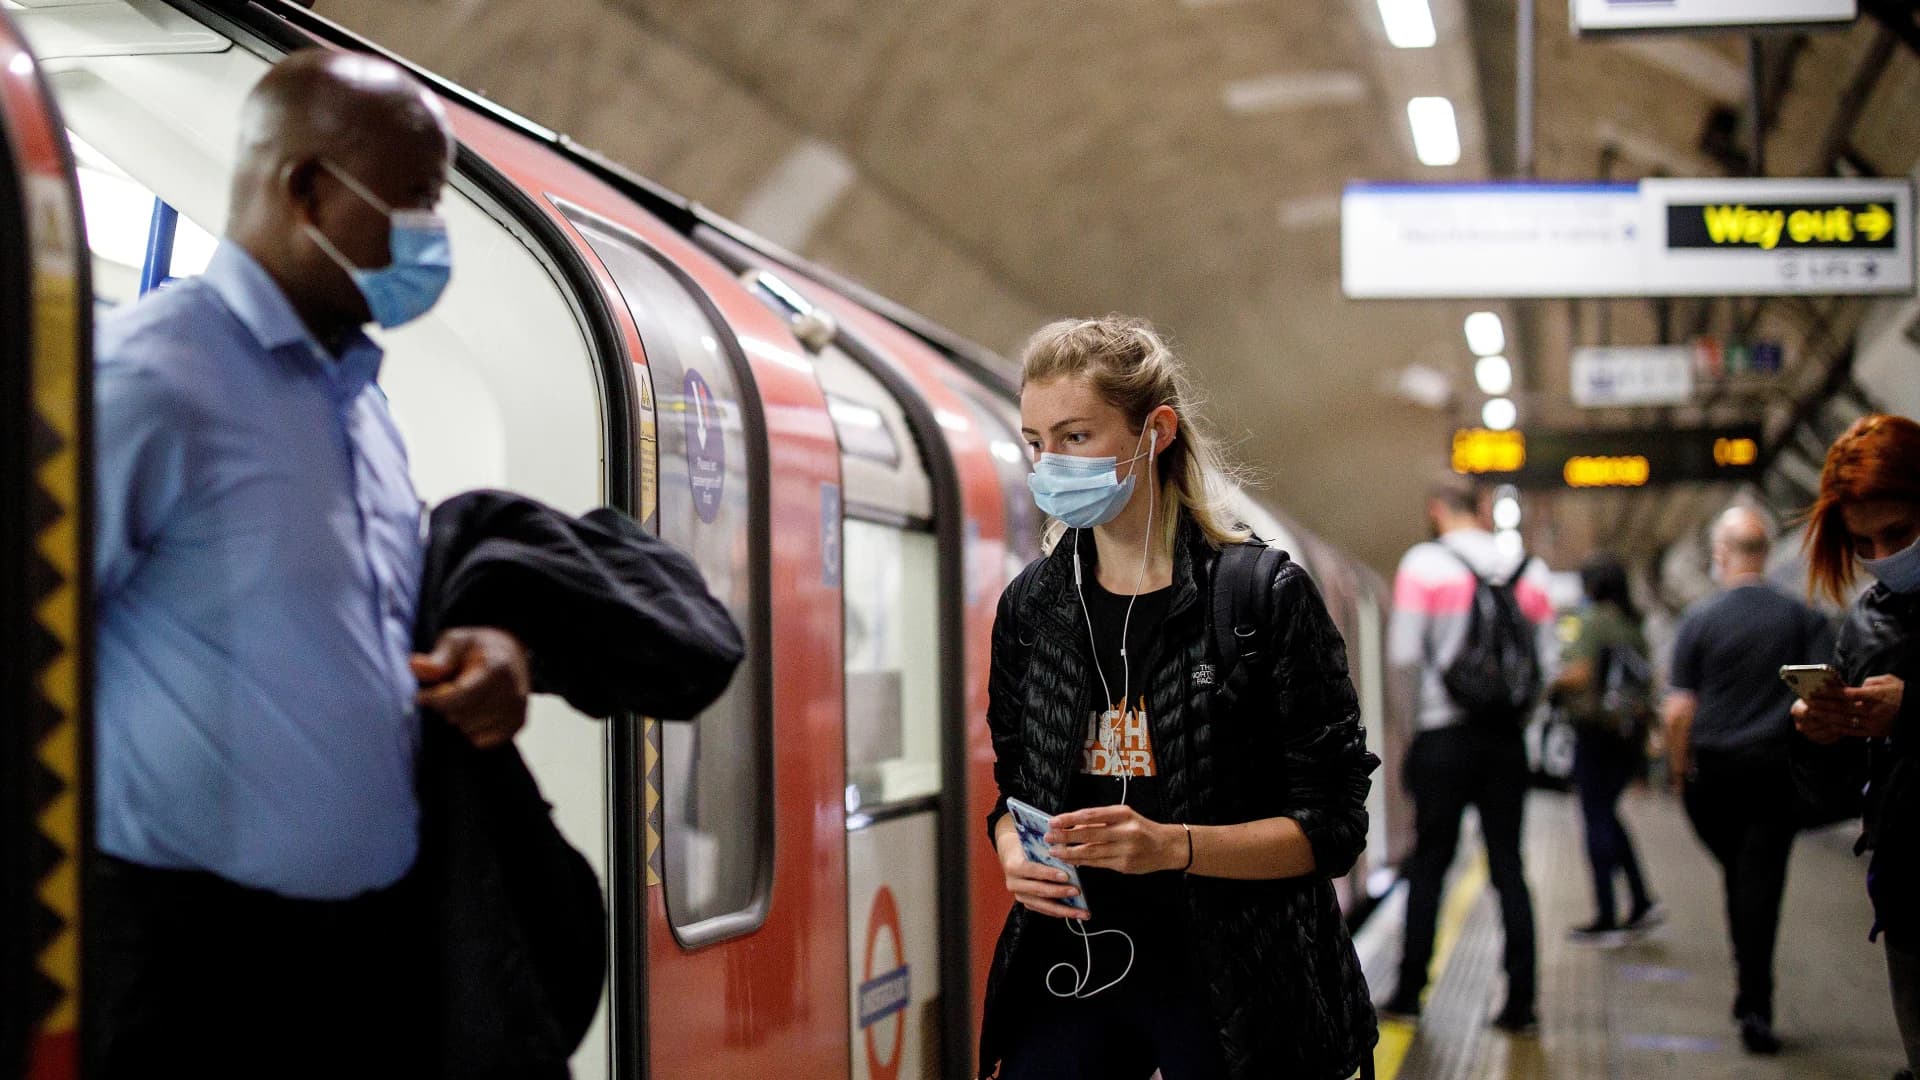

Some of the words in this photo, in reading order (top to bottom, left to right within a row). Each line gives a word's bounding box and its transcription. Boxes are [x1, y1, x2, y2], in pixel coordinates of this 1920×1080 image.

[1704, 203, 1785, 249] Way
[1788, 206, 1854, 243] out
[1199, 663, 1216, 671] THE
